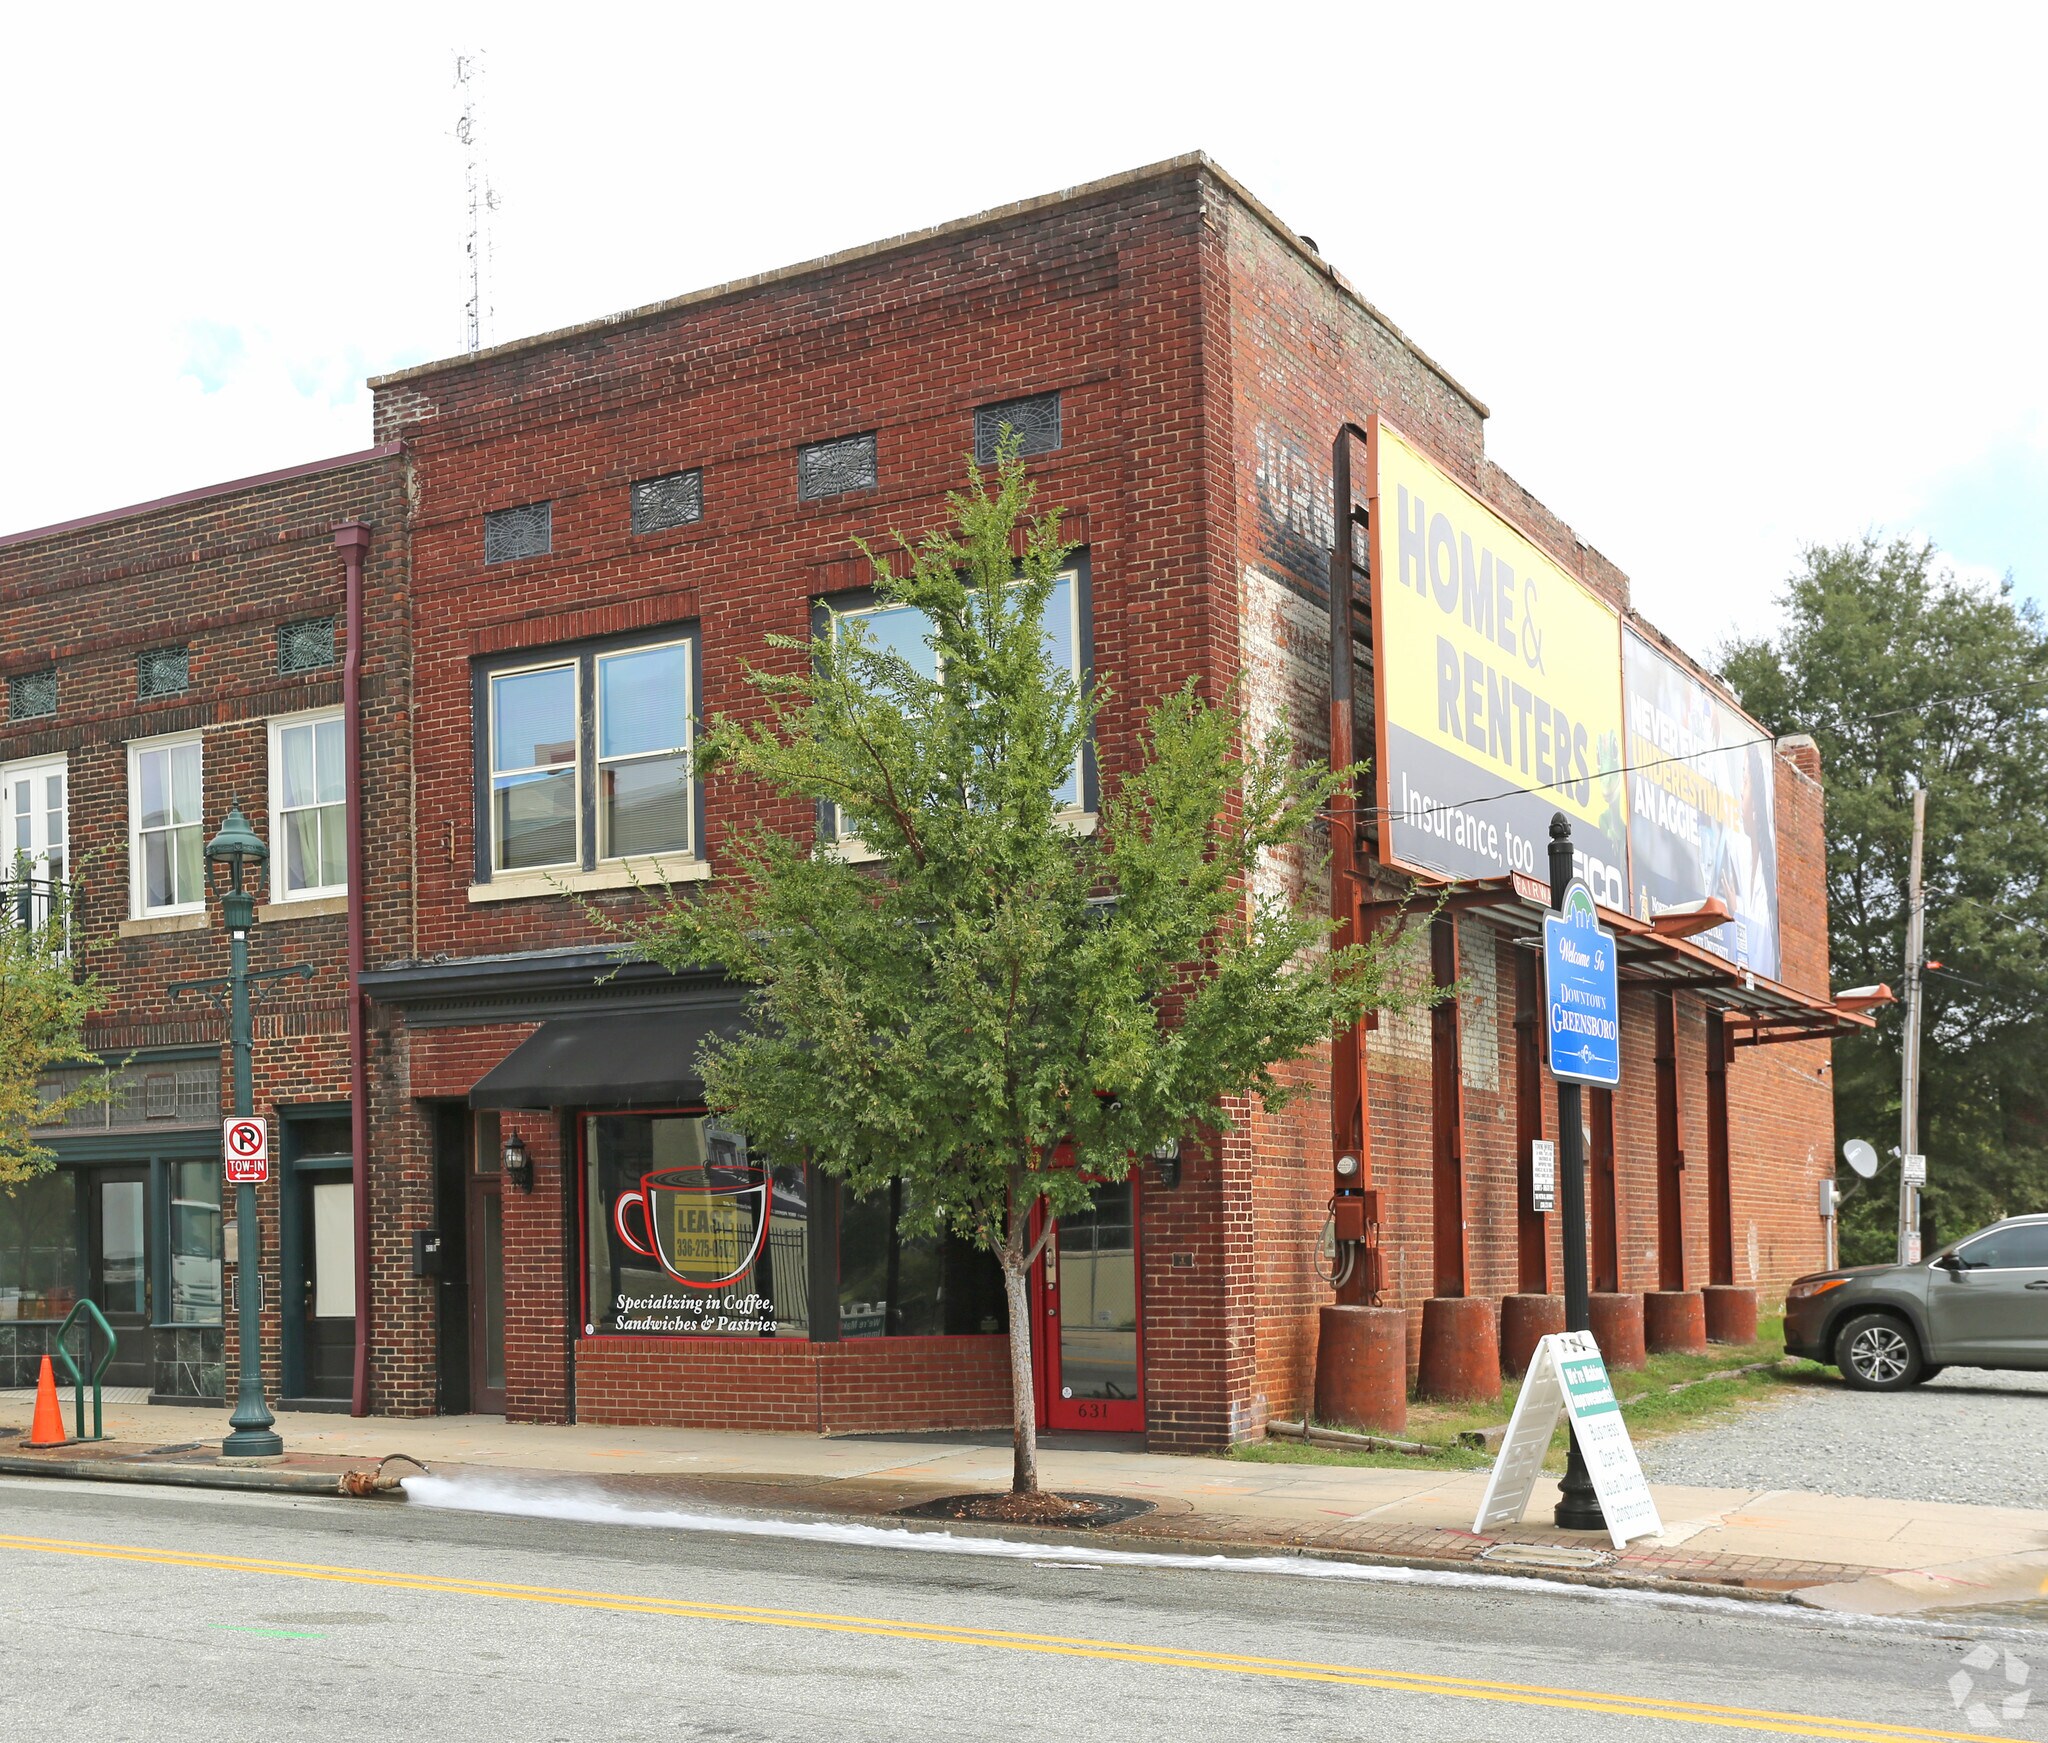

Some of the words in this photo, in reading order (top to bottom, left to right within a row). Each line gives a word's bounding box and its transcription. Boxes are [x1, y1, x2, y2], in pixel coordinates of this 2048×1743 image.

[1397, 483, 1517, 656] HOME
[1521, 577, 1546, 676] &
[1436, 634, 1590, 808] RENTERS
[1630, 690, 1679, 761] NEVER
[1632, 731, 1741, 833] UNDERESTIMATE
[1402, 771, 1503, 868] Insurance,
[1505, 822, 1534, 874] too
[1634, 774, 1657, 824] AN
[1657, 793, 1701, 847] AGGIE
[1516, 877, 1551, 903] FAIRWA
[1572, 849, 1624, 912] EICO
[1560, 937, 1590, 968] Welcome
[1594, 949, 1605, 972] To
[229, 1160, 265, 1172] TOW-IN
[678, 1210, 733, 1234] LEASE
[616, 1294, 703, 1314] Specializing
[705, 1294, 720, 1310] in
[723, 1293, 774, 1314] Coffee,
[615, 1314, 697, 1331] Sandwiches
[700, 1314, 715, 1331] &
[716, 1315, 778, 1331] Pastries
[1564, 1367, 1585, 1386] We're
[1581, 1364, 1606, 1384] Making
[1078, 1403, 1107, 1418] 631
